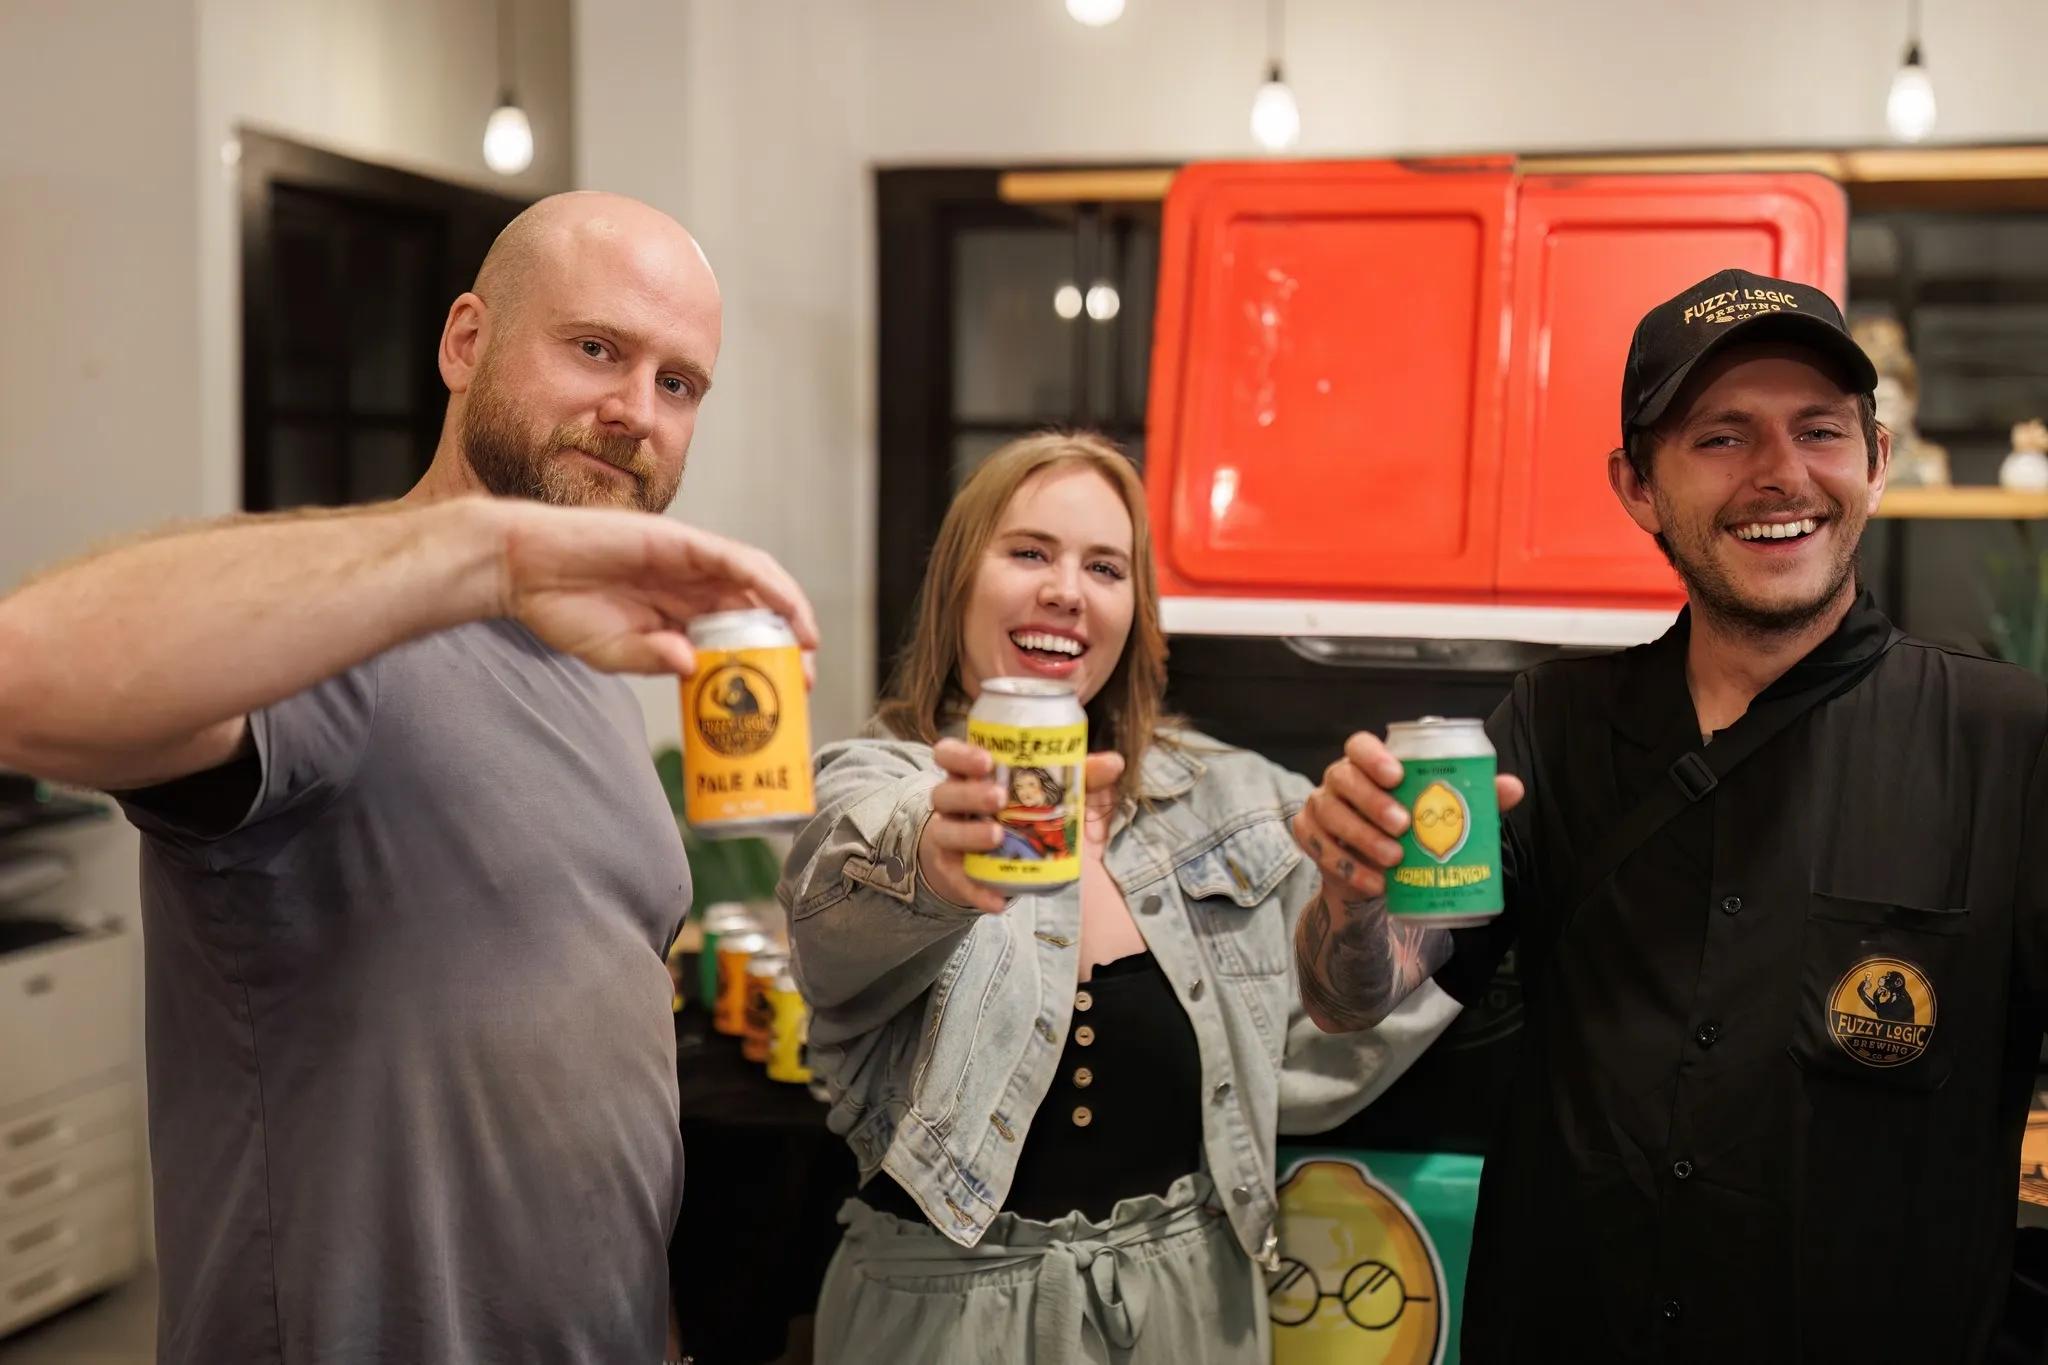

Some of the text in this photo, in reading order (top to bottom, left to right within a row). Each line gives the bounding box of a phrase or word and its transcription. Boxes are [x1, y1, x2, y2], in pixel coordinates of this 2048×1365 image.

[1684, 288, 1798, 324] FUZZY LOGIC
[1706, 302, 1781, 323] BREWING
[696, 766, 788, 797] PALE ALE
[1437, 864, 1491, 888] LEMON
[1837, 1013, 1926, 1046] FUZZY LOGIC
[1853, 1040, 1908, 1055] BREWING
